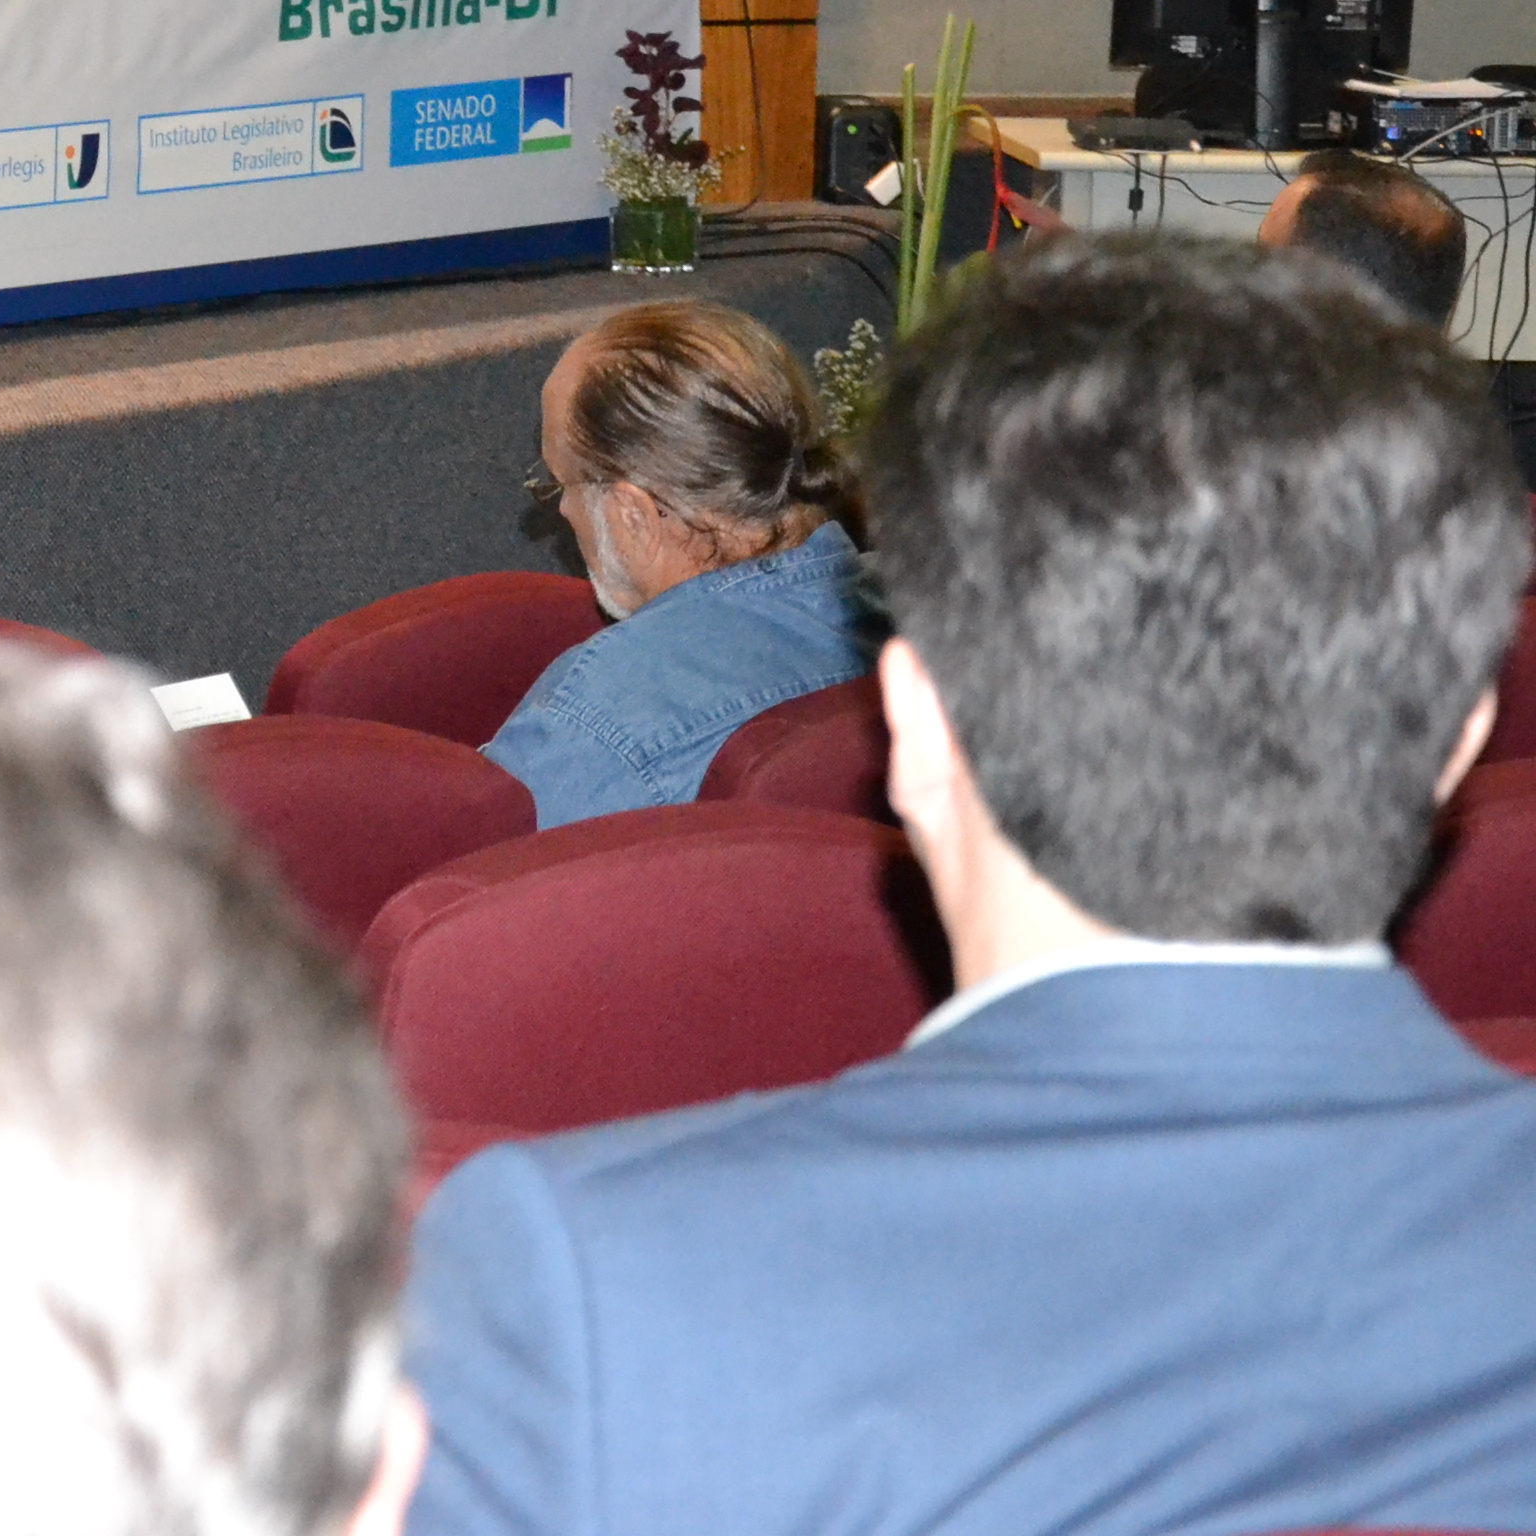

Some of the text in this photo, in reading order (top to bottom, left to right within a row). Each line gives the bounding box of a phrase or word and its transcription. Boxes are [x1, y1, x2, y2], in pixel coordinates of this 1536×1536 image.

[415, 94, 497, 125] SENADO
[148, 114, 305, 150] Instituto Legislativo
[414, 120, 497, 152] FEDERAL
[231, 146, 305, 173] Brasileiro
